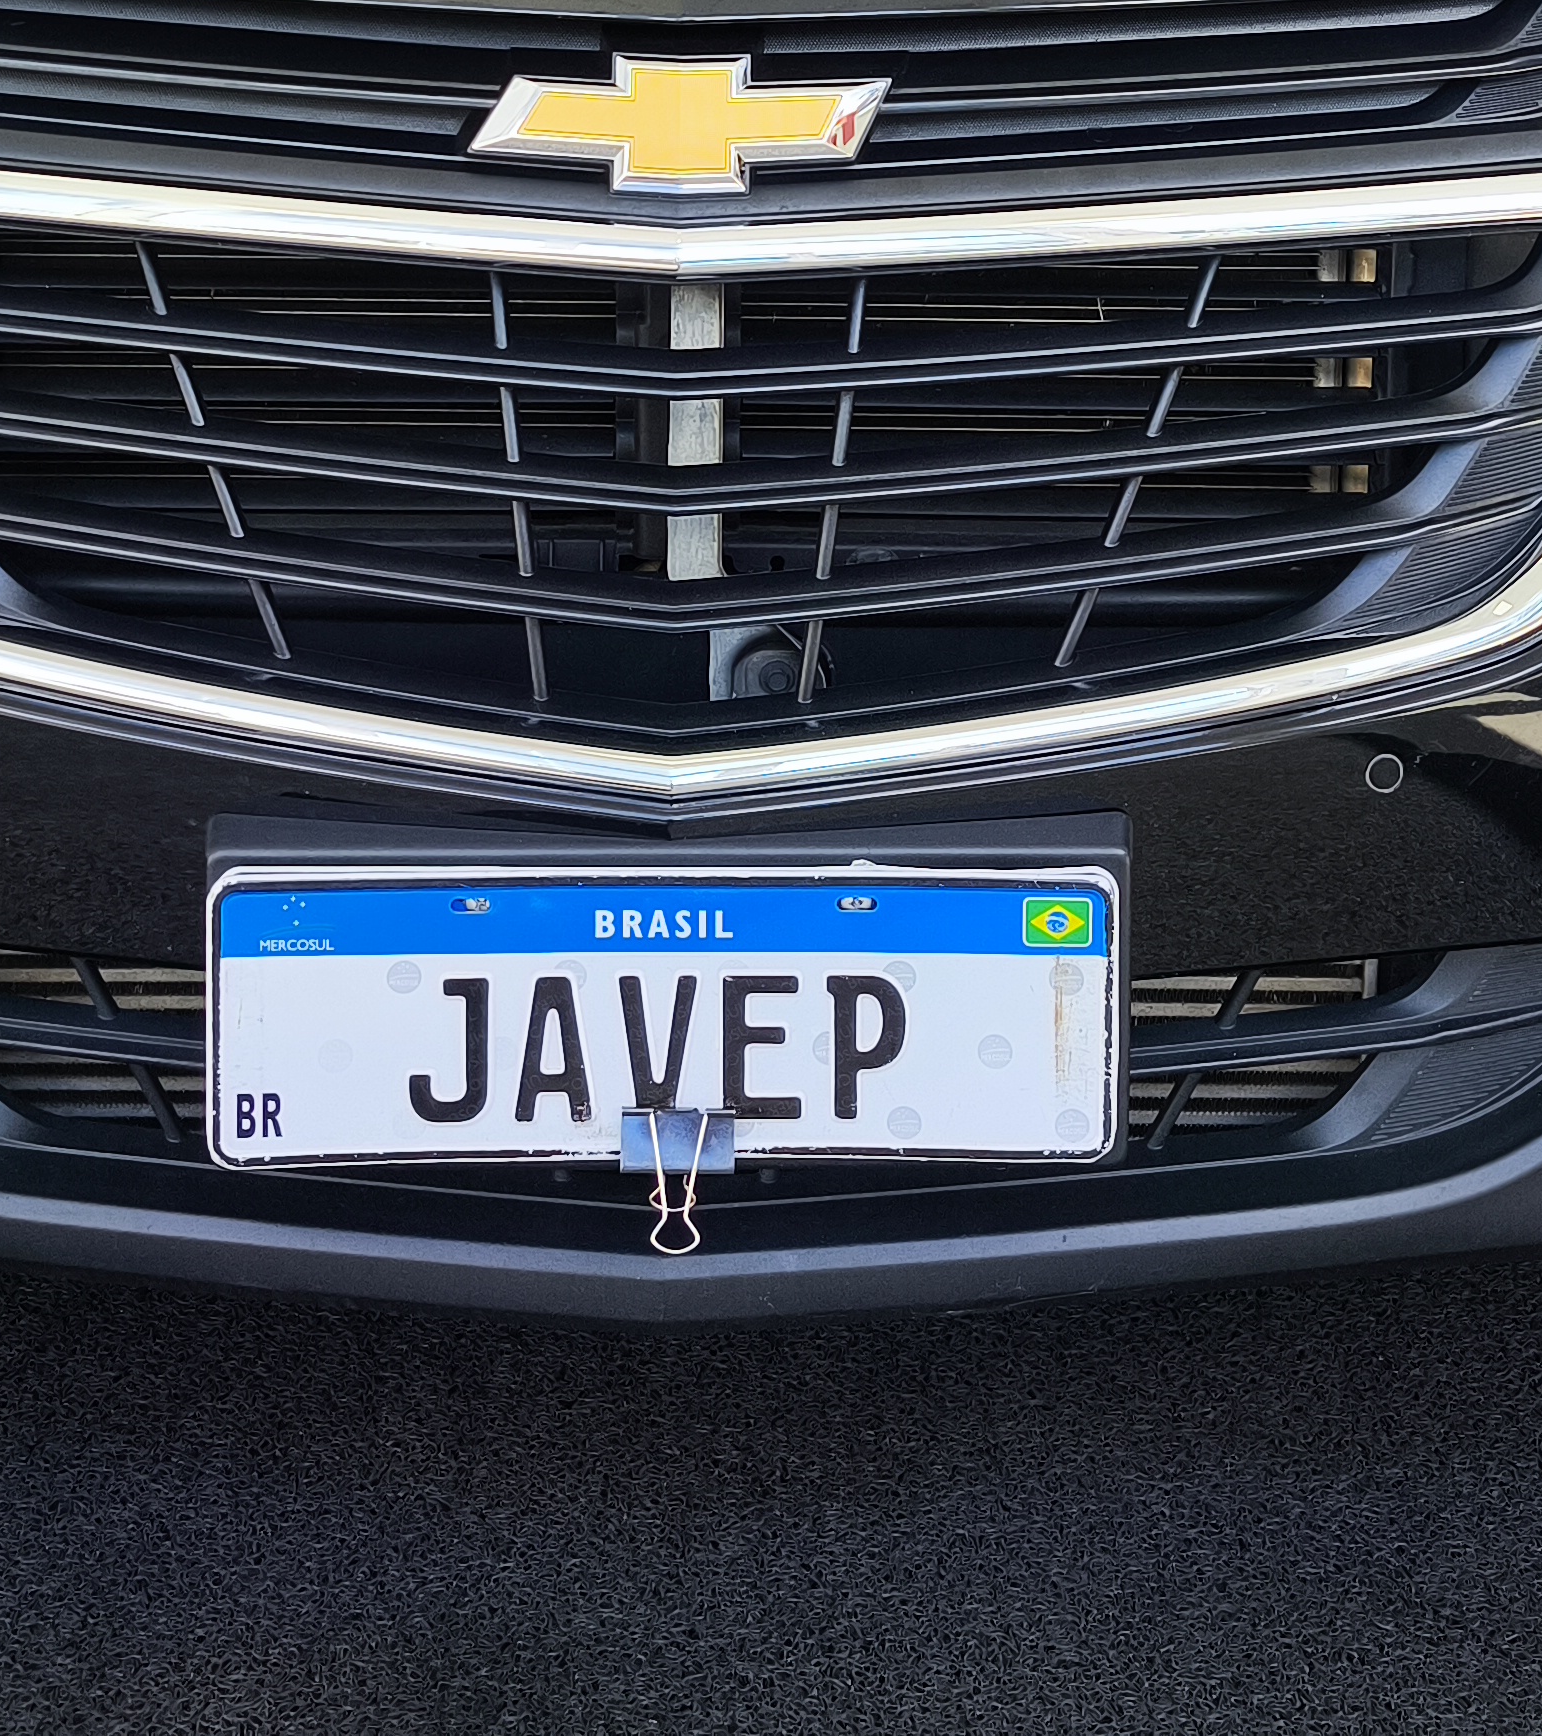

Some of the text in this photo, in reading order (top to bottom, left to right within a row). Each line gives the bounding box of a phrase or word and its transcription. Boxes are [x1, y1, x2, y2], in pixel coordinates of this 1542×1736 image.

[594, 909, 734, 939] BRASIL
[259, 938, 335, 952] MERCOSUL
[408, 974, 907, 1123] JAVEP
[236, 1092, 283, 1139] BR
